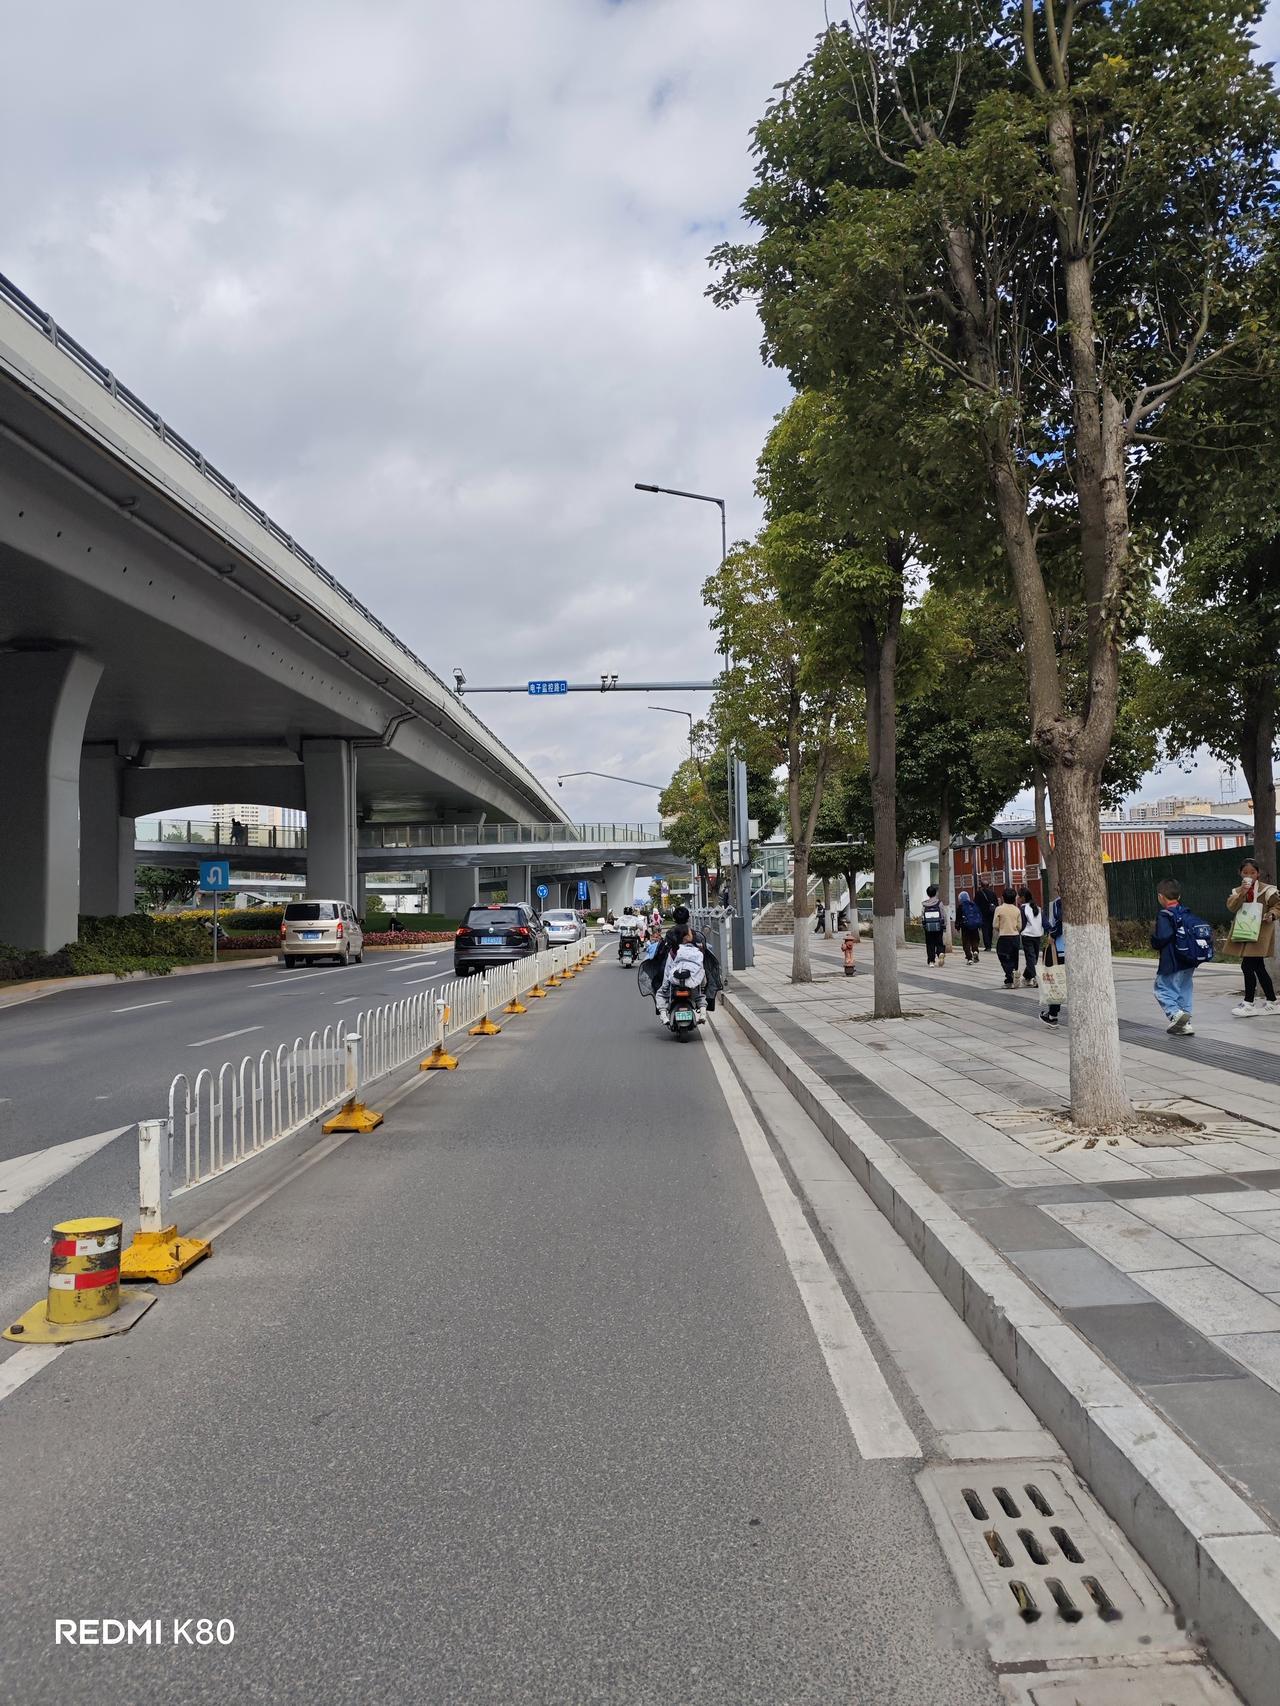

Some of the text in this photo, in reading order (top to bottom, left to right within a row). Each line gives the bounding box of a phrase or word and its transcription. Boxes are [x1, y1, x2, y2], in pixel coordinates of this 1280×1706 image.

[530, 682, 566, 693] 电子监控路口
